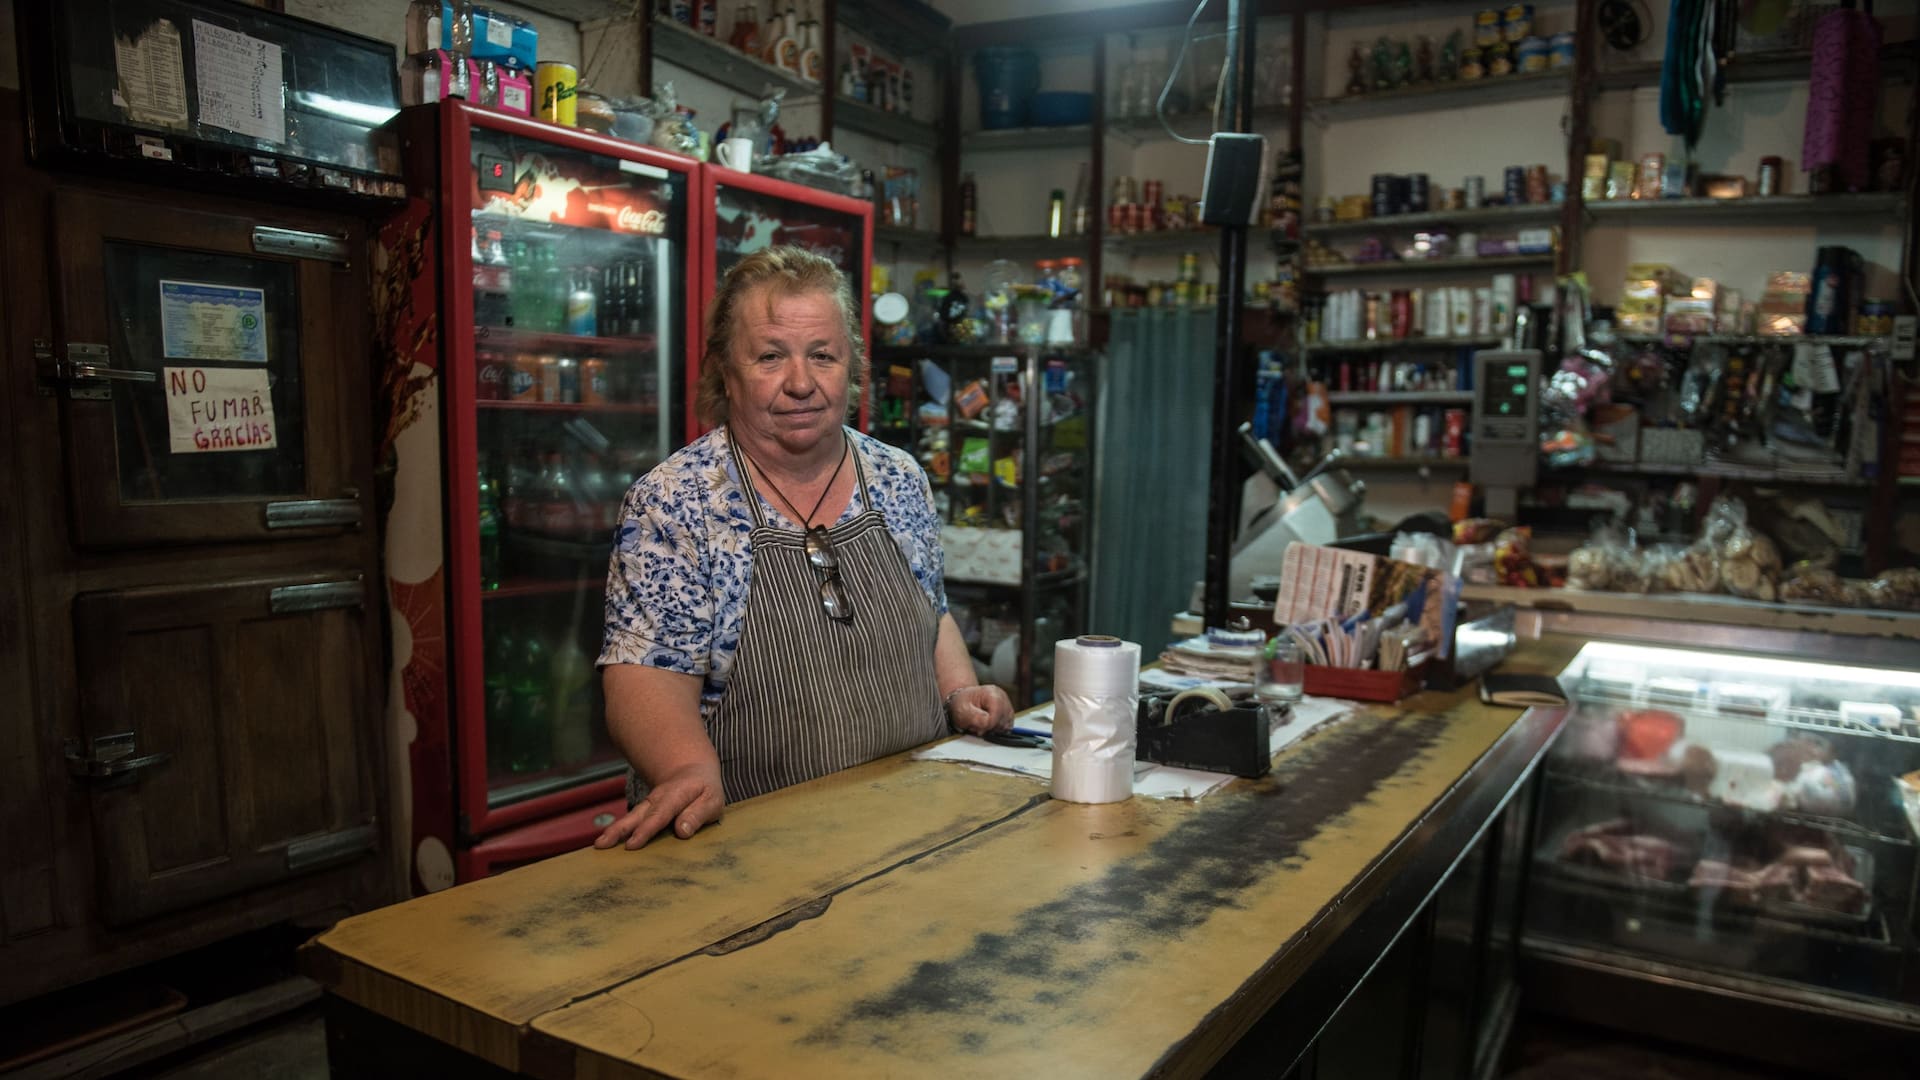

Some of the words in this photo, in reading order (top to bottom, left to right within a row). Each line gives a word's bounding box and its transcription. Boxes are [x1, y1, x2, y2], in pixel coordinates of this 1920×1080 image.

[494, 163, 503, 178] 6
[171, 369, 206, 396] NO
[191, 396, 264, 424] FUMAR
[194, 423, 272, 449] GRACIAS
